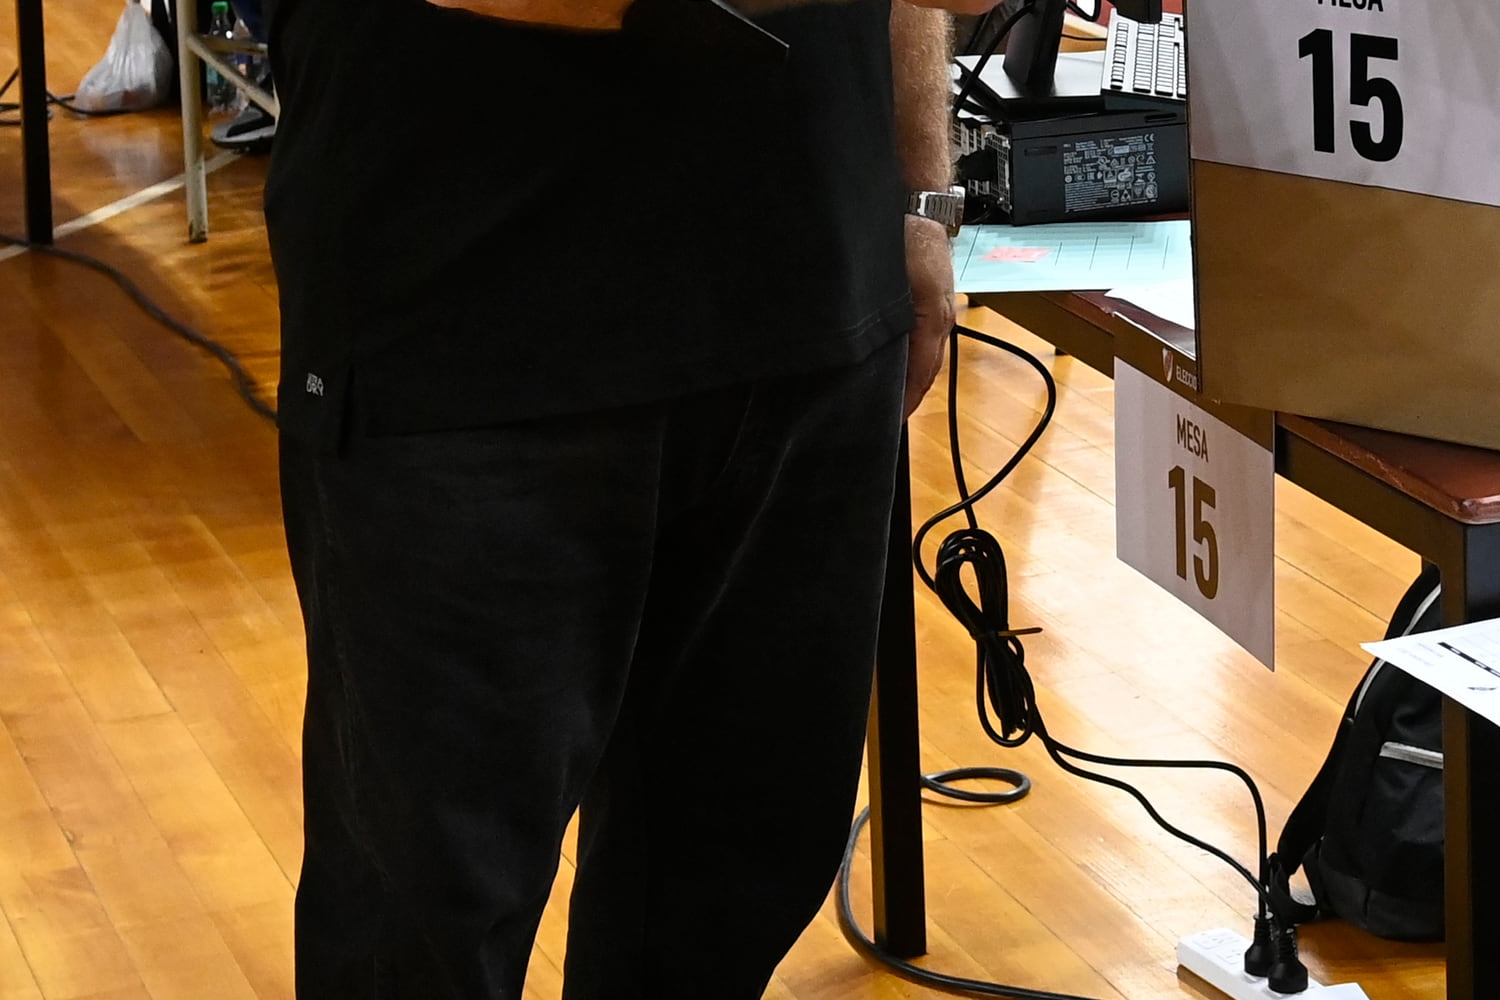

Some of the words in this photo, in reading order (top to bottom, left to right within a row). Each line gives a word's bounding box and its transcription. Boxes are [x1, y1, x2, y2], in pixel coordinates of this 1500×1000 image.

[1298, 28, 1404, 163] 15
[1176, 365, 1198, 391] ELECCIO
[1176, 413, 1209, 463] MESA
[1168, 464, 1219, 600] 15
